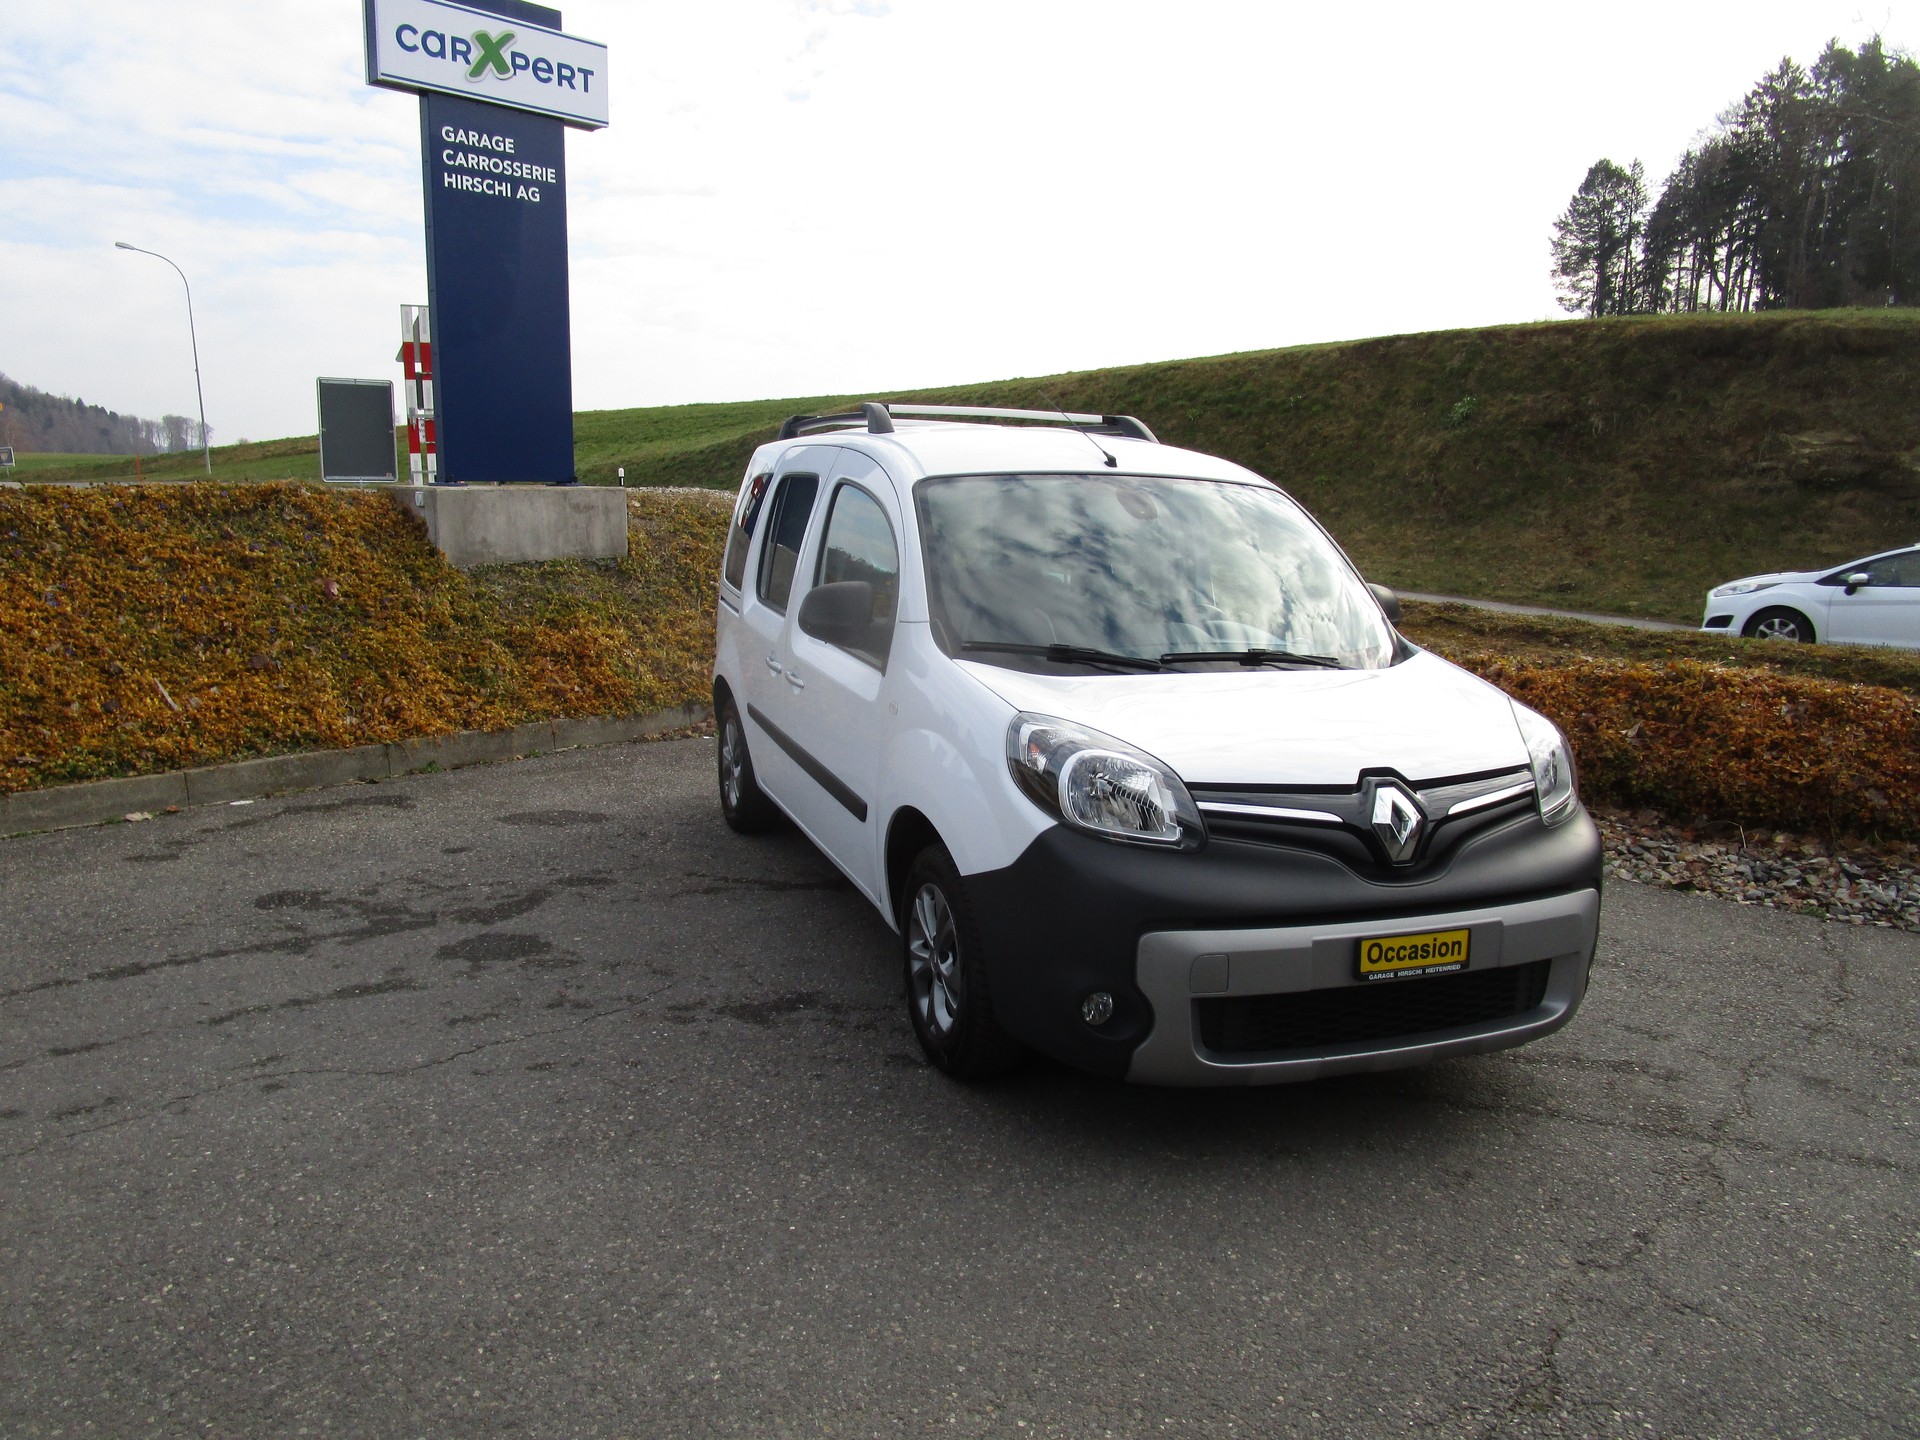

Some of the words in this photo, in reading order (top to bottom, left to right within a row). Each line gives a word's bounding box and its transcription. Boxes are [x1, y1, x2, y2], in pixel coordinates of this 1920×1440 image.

[442, 126, 514, 153] GARAGE
[442, 150, 556, 183] CARROSSERIE
[444, 172, 511, 198] HIRSCHI
[517, 185, 540, 202] AG
[1367, 937, 1462, 964] Occasion
[1368, 972, 1394, 980] GARAGE
[1398, 969, 1422, 977] HIRSCHI
